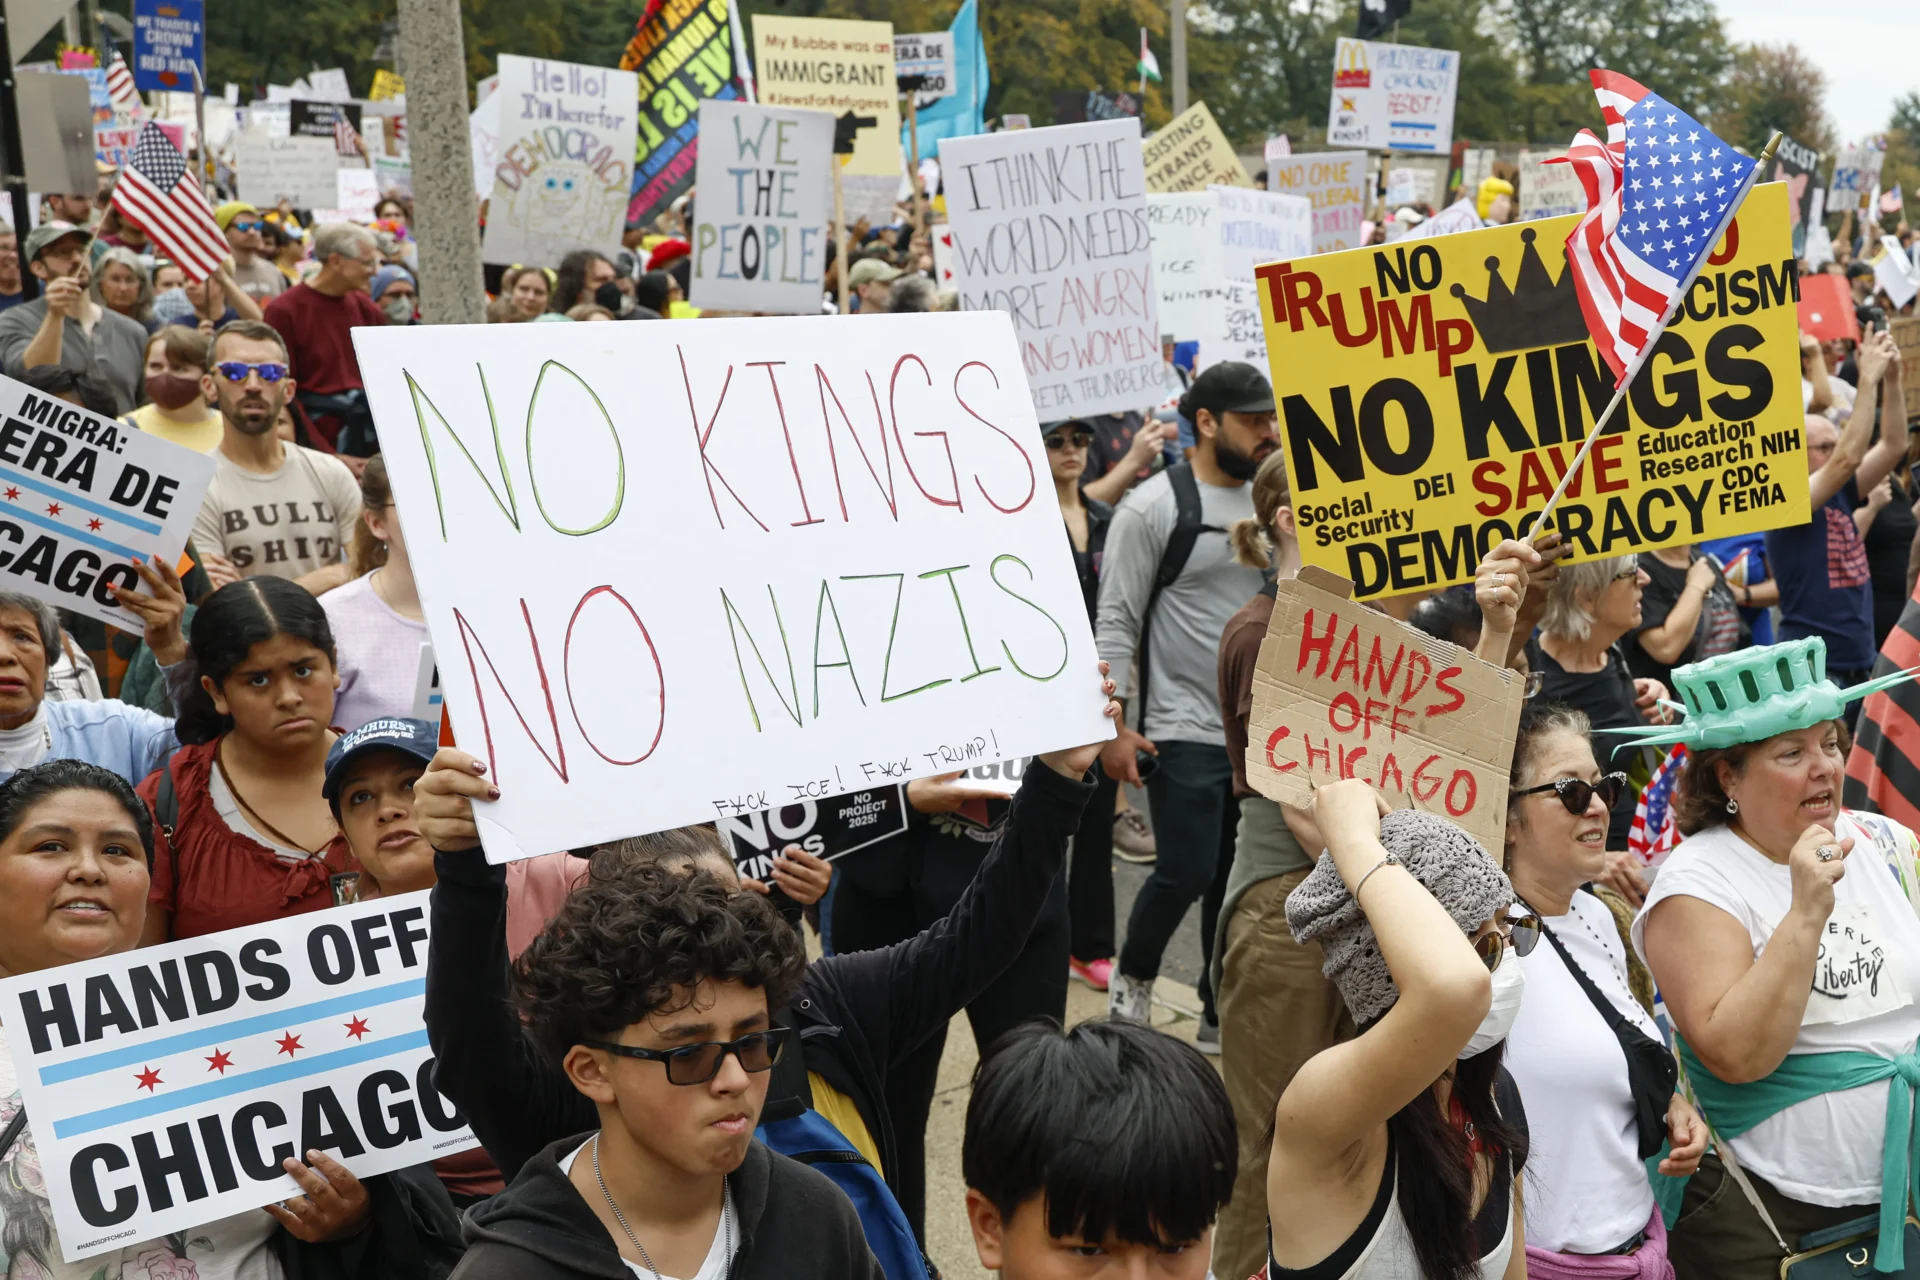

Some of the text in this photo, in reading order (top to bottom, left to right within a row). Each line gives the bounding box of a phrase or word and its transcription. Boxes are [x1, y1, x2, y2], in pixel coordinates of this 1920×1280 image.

[145, 29, 194, 48] CROWN
[154, 44, 183, 58] FOR A
[765, 34, 891, 54] My Bubbe was an
[895, 44, 943, 61] ERA DE
[140, 54, 193, 74] RED HAT
[532, 60, 607, 99] Hello!
[765, 59, 885, 87] IMMIGRANT
[557, 98, 598, 125] here
[598, 104, 626, 130] for
[767, 93, 889, 111] #JewsForRefugees
[495, 125, 629, 193] DEMOCRACY
[733, 114, 799, 165] WE
[1143, 113, 1205, 168] ESISTING
[960, 138, 1141, 212] I THINK THE
[1146, 135, 1213, 190] TYRANTS
[1167, 158, 1215, 192] SINCE
[1278, 160, 1354, 188] NO ONE
[727, 167, 800, 219] THE
[695, 222, 821, 285] PEOPLE
[953, 213, 1067, 277] WORLD
[1068, 208, 1152, 266] NEEDS
[1161, 259, 1196, 273] ICE
[1373, 244, 1443, 298] NO
[1057, 264, 1151, 327] ANGRY
[1666, 258, 1801, 327] CISM
[1254, 262, 1475, 378] TRUMP
[1071, 322, 1160, 372] WOMEN
[1030, 361, 1167, 409] RETA THUNBERG
[1281, 377, 1435, 492] NO
[1453, 323, 1774, 462] KINGS
[18, 393, 128, 455] MIGRA:
[402, 344, 1036, 543] NO KINGS
[1637, 420, 1756, 457] Education
[0, 414, 180, 520] ERA DE
[1471, 435, 1630, 517] SAVE
[1640, 428, 1802, 482] Research NIH
[1721, 462, 1770, 491] CDC
[1413, 472, 1456, 501] DEI
[1718, 482, 1787, 516] FEMA
[223, 501, 335, 534] BULL
[1297, 491, 1374, 528] Social
[1315, 508, 1415, 548] Security
[231, 537, 334, 569] SHIT
[452, 553, 1069, 786] NO NAZIS
[1297, 608, 1466, 718] HANDS
[342, 720, 415, 750] ELMHURST
[1328, 691, 1417, 743] OFF
[923, 728, 1002, 771] TRUMP!
[1265, 725, 1478, 817] CHICAGO
[838, 799, 888, 819] PROJECT
[848, 813, 878, 829] 2025!
[853, 792, 872, 805] NO
[714, 800, 819, 860] NO
[18, 906, 428, 1055] HANDS OFF
[69, 1057, 469, 1229] CHICAGO
[432, 1134, 477, 1150] HANDSOFFCHICAG
[76, 1229, 137, 1251] #HANDSOFFCHICAGO
